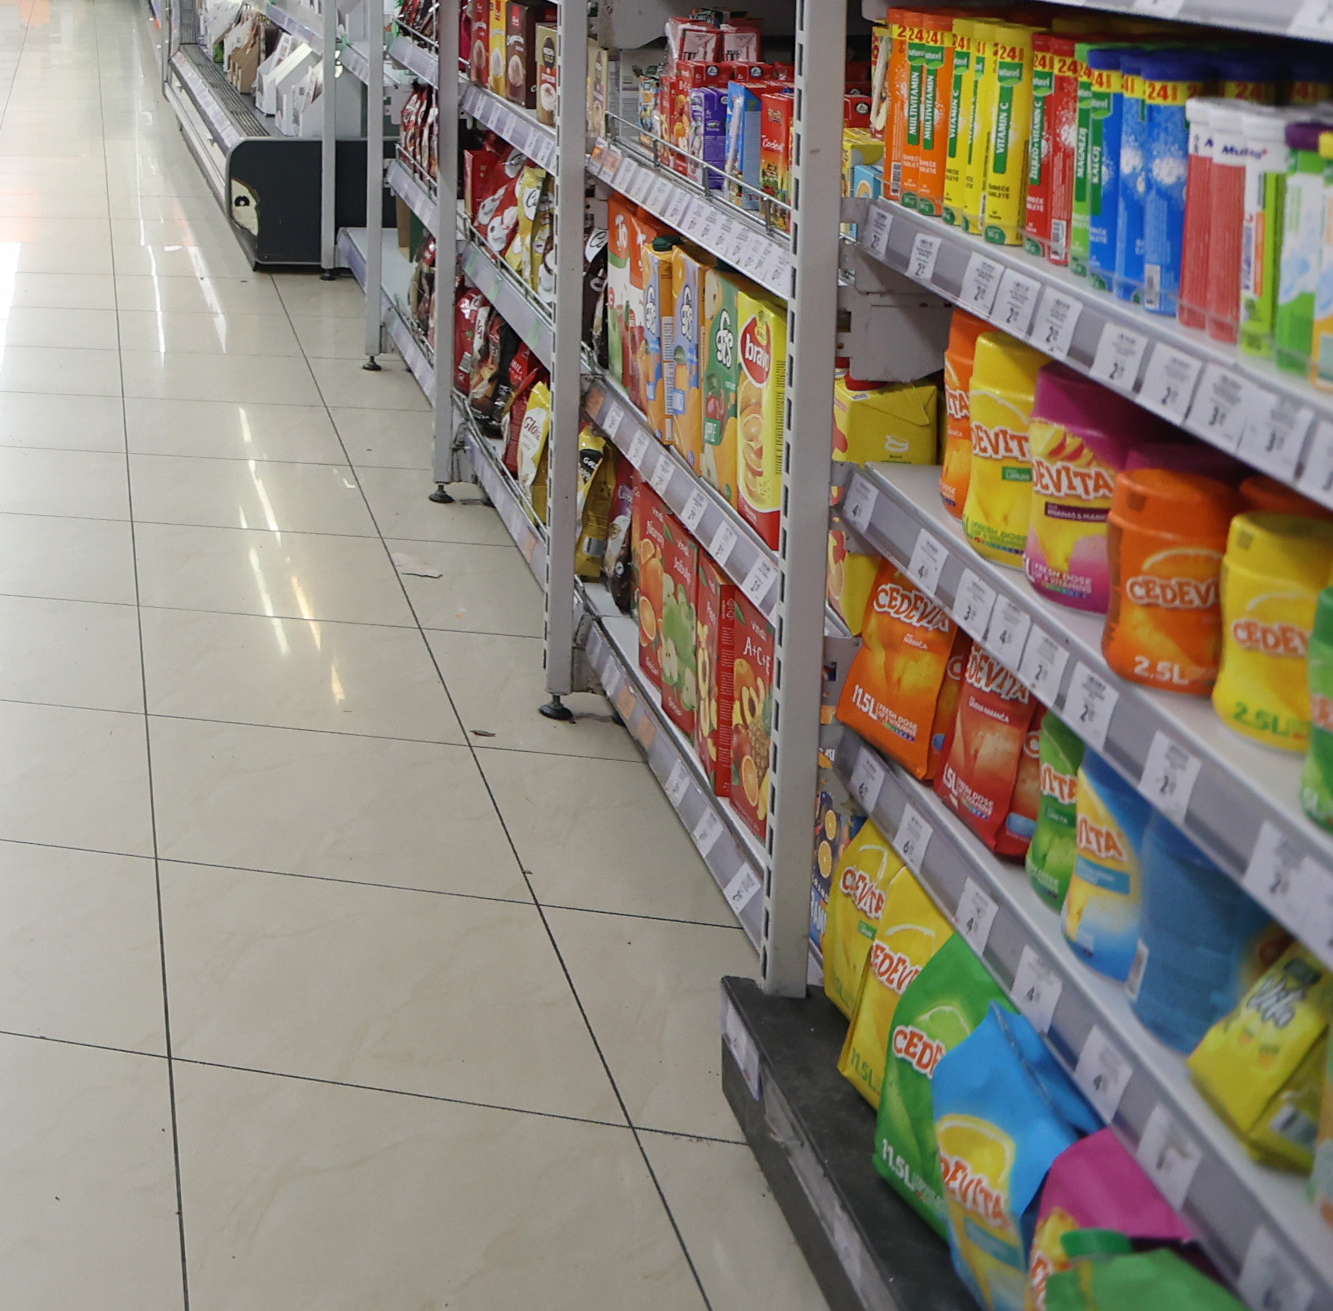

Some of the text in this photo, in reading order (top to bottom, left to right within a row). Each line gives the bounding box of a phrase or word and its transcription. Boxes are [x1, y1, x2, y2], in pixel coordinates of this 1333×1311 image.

[998, 44, 1018, 60] 24
[1058, 58, 1078, 75] 24
[907, 70, 920, 136] MULTIVITAMIN
[923, 74, 935, 139] MULTIVITAMIN
[1147, 84, 1170, 100] 24
[995, 102, 1008, 155] VITAMIN C
[873, 583, 951, 633] CEDEVITA
[750, 620, 768, 641] vindi
[743, 636, 772, 675] A+C+E
